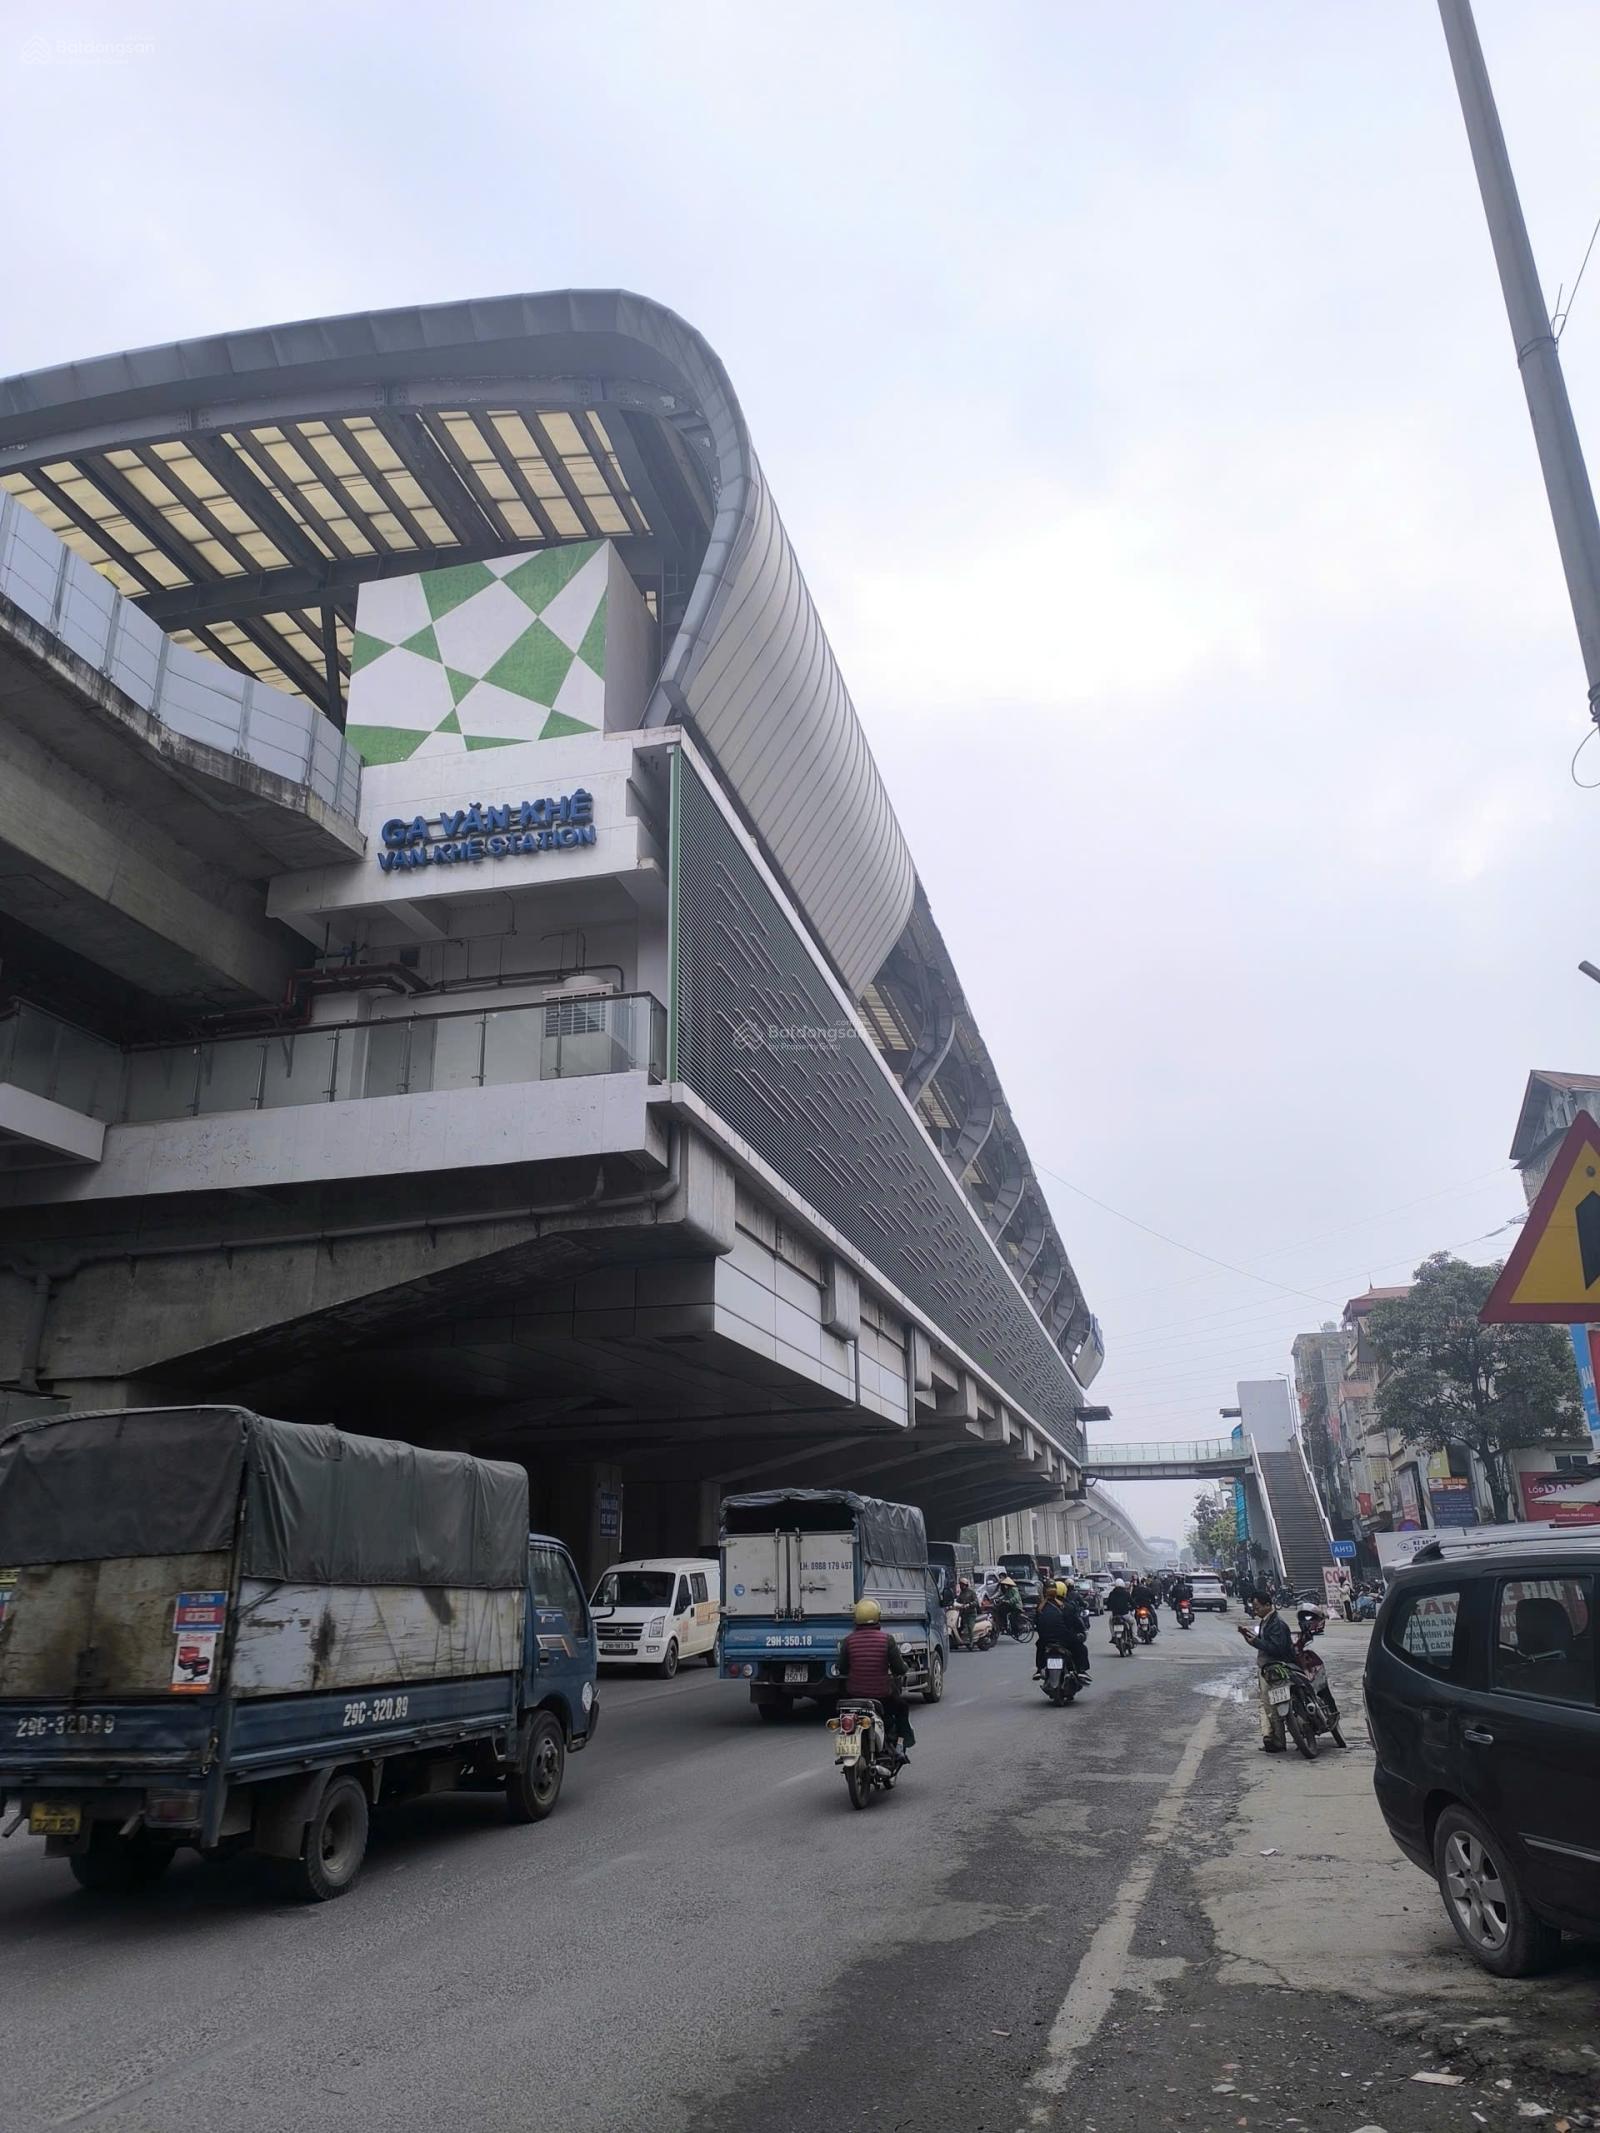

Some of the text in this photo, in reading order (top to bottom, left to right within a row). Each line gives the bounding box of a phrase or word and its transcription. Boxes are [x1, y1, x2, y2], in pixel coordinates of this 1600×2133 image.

[381, 788, 594, 848] GA VĂN KHÊ
[378, 845, 427, 872] VAN
[486, 825, 597, 859] STATION
[765, 1635, 812, 1647] 29H-350.18
[343, 1696, 409, 1727] 29C-320.89
